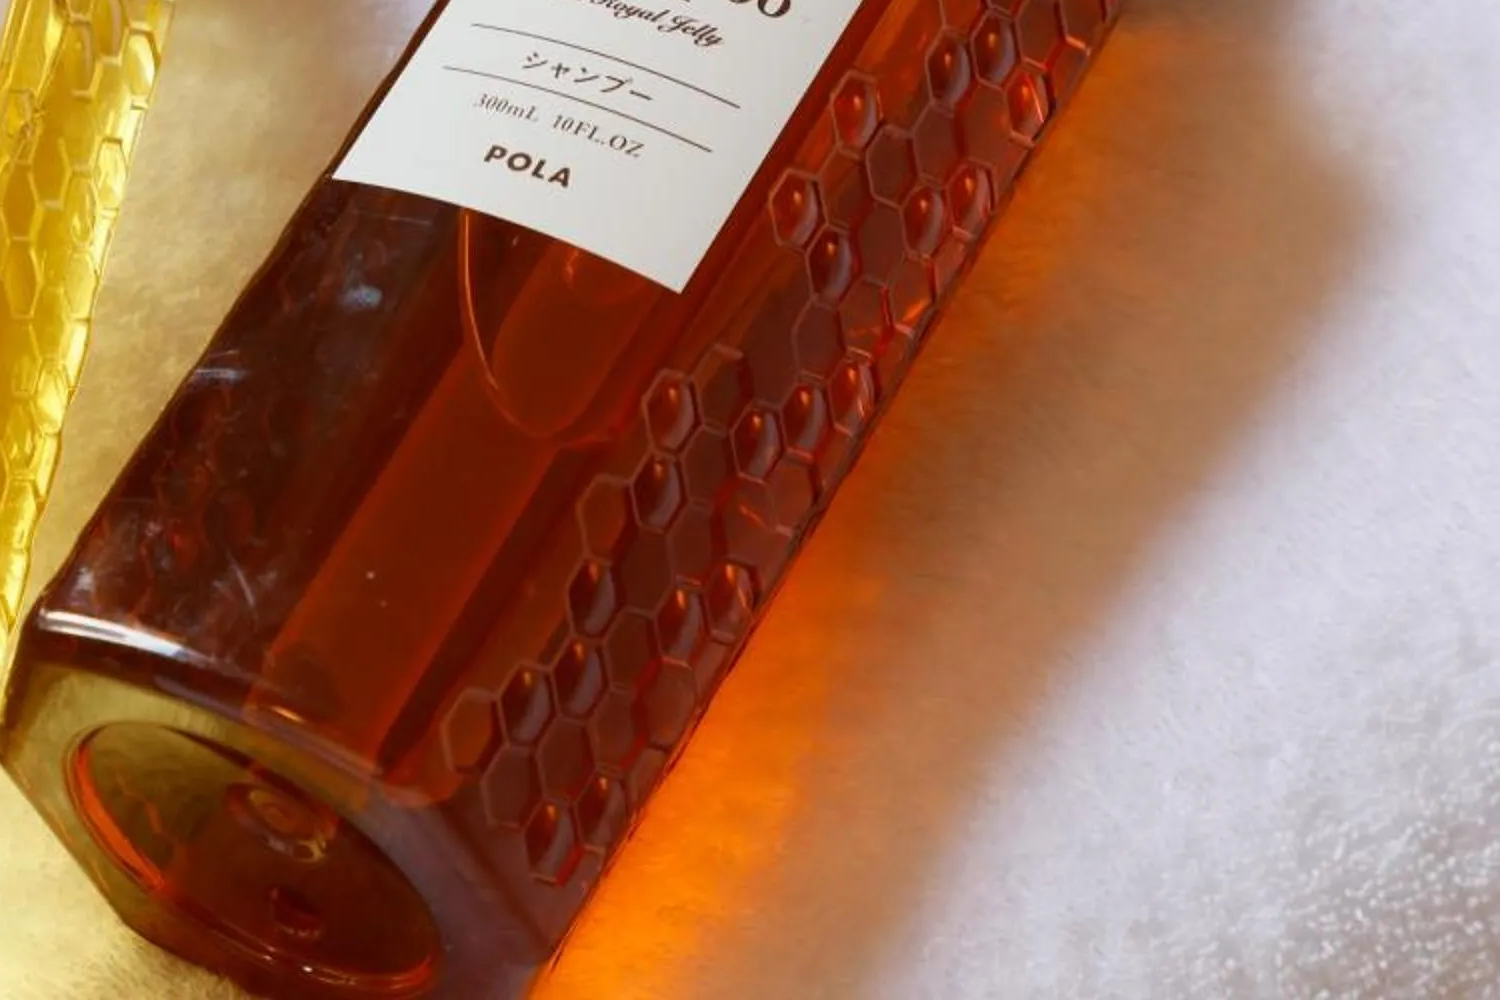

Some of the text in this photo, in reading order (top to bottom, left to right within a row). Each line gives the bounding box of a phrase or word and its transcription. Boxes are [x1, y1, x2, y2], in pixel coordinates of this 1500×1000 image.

[657, 13, 725, 48] Jelly
[522, 51, 654, 102] シャンプー
[473, 93, 645, 158] 300mL 10FL.OZ
[483, 144, 572, 188] POLA
